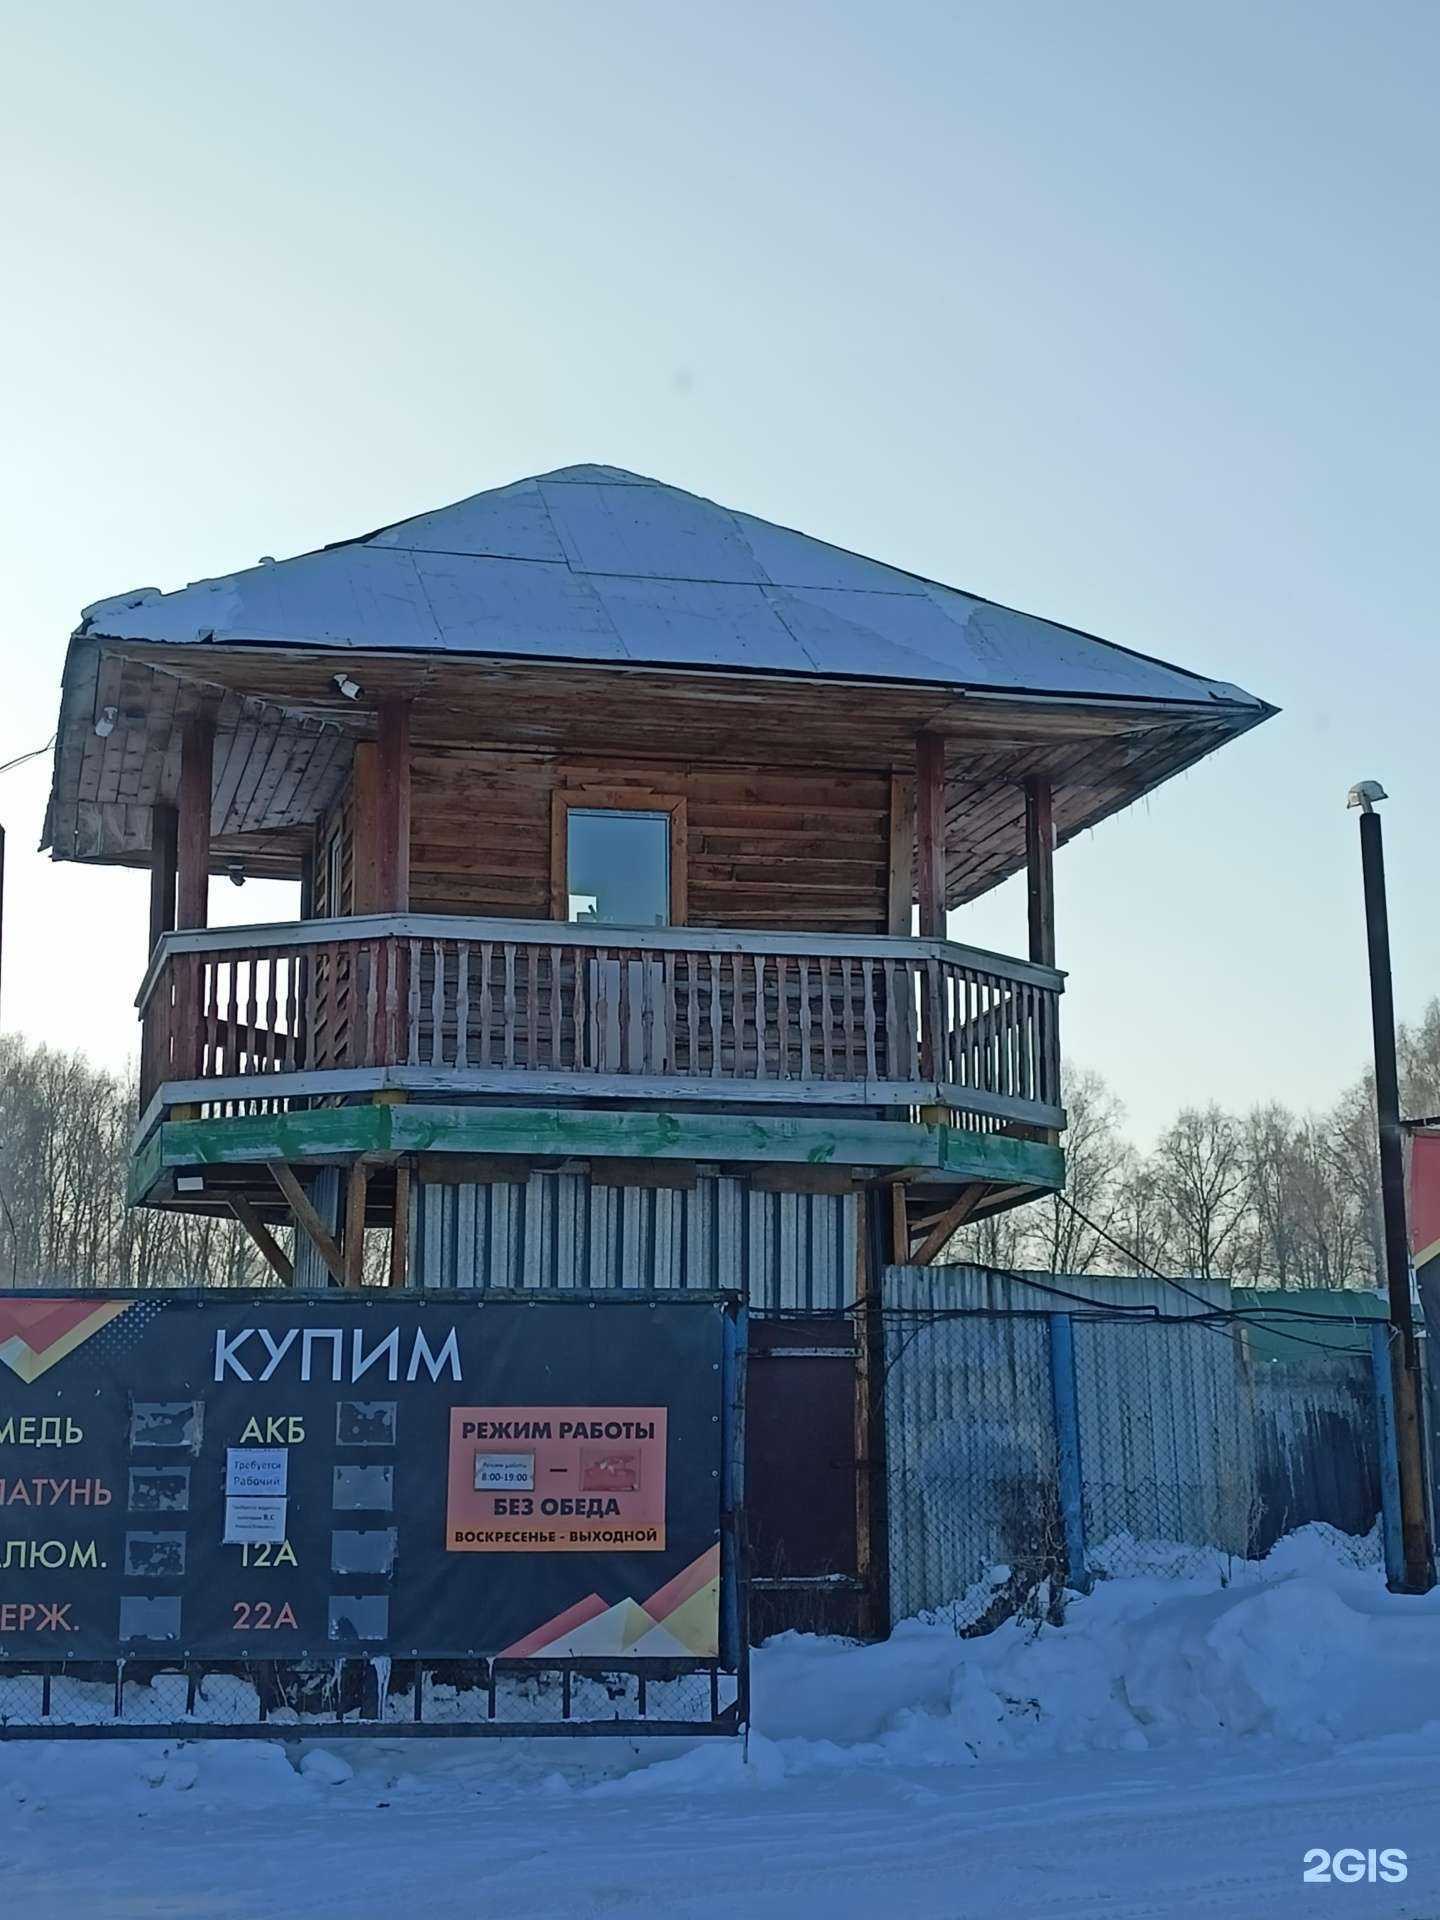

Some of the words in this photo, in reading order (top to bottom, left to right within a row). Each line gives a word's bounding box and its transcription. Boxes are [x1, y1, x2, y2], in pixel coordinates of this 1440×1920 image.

[214, 1326, 462, 1383] КУПИМ
[240, 1416, 306, 1444] АКБ
[462, 1422, 552, 1440] РЕЖИМ
[559, 1422, 655, 1440] РАБОТЫ
[0, 1478, 112, 1506] АТУНЬ
[494, 1498, 533, 1516] БЕЗ
[541, 1498, 620, 1518] ОБЕДА
[455, 1531, 555, 1543] ВОСКРЕСЕНЬЕ
[569, 1528, 657, 1544] ВЫХОДНОЙ
[0, 1540, 107, 1568] ЛЮМ.
[233, 1602, 299, 1630] 22А
